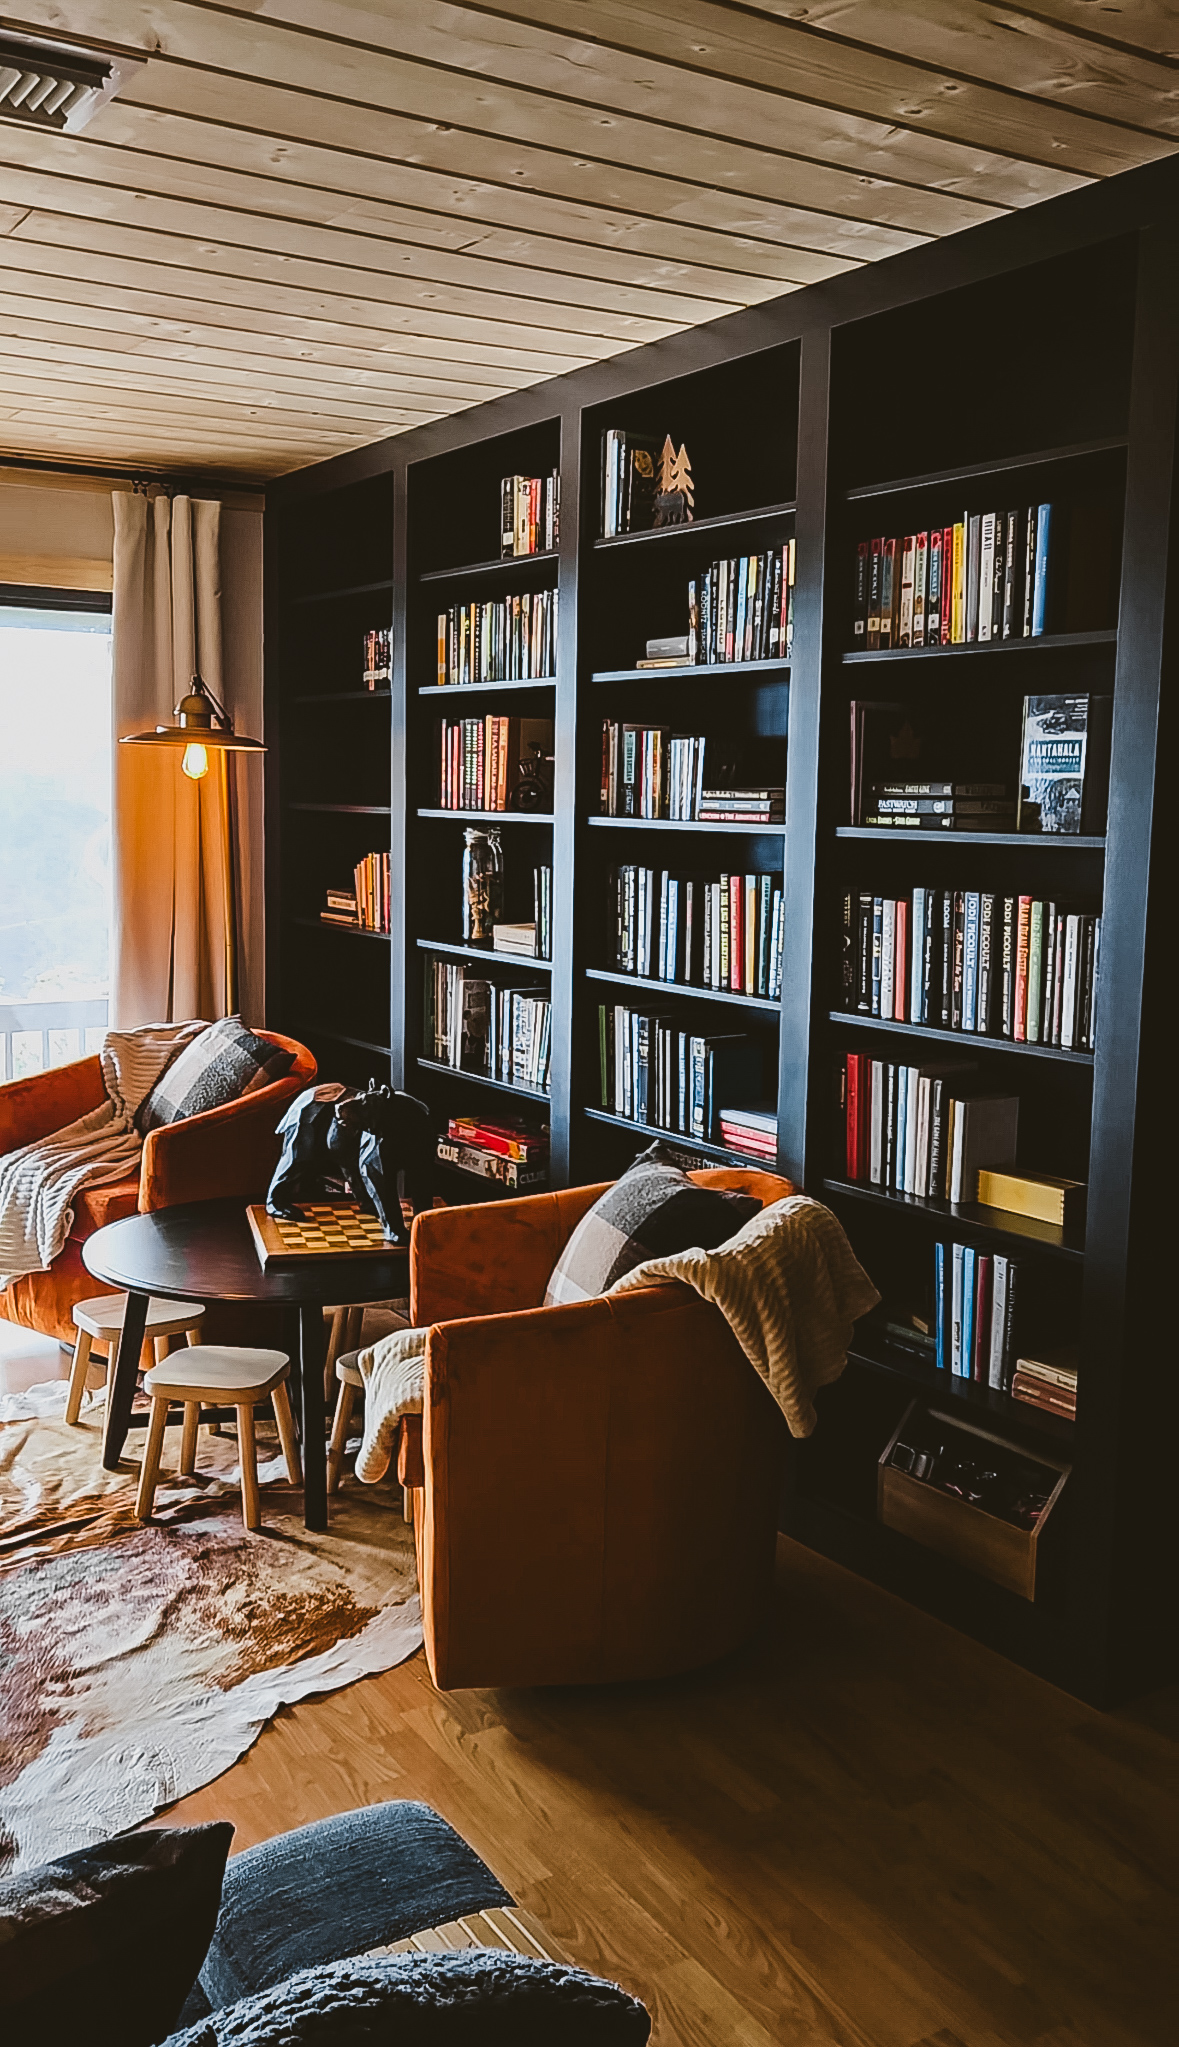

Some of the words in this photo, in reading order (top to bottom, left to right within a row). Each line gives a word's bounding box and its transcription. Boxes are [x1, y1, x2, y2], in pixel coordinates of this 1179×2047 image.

[1030, 743, 1080, 757] NANTAHALA
[967, 896, 977, 921] JODI
[983, 897, 993, 923] JODI
[1003, 897, 1014, 923] JODI
[1020, 903, 1030, 924] ALAN
[966, 923, 976, 967] PICOULT
[982, 925, 991, 970] PICOULT
[1003, 926, 1012, 971] PICOULT
[437, 1143, 460, 1163] CLUE
